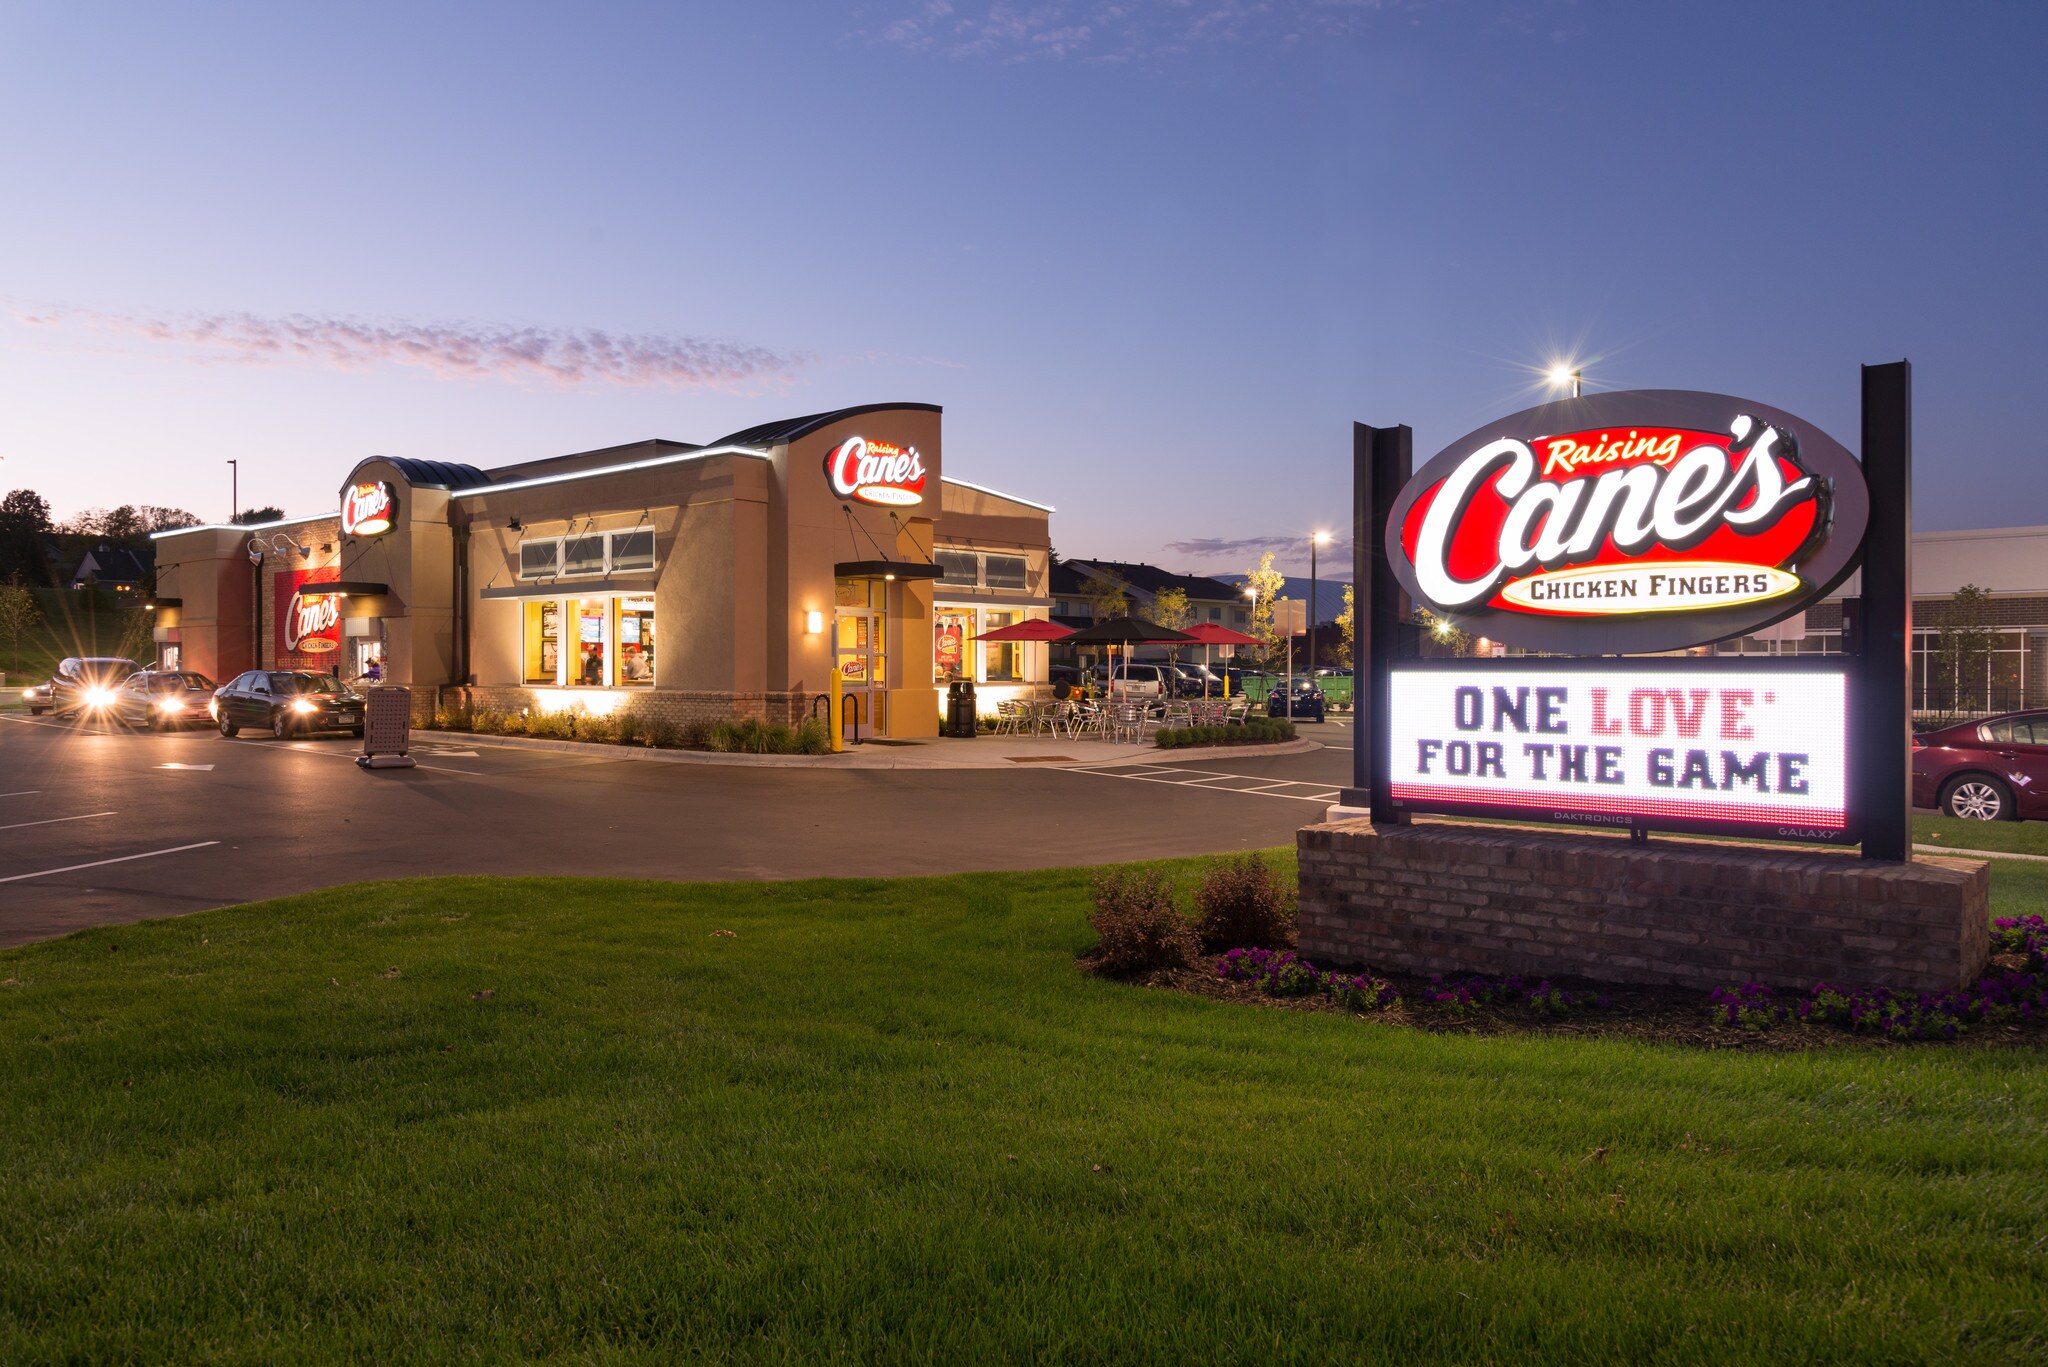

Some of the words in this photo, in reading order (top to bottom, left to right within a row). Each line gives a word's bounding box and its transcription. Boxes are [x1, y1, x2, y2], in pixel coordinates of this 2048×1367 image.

[834, 436, 926, 495] Cane's
[866, 441, 899, 458] Raising
[1543, 433, 1682, 476] Raising
[342, 481, 389, 534] Cane's
[1415, 414, 1809, 605] Cane's
[1530, 579, 1638, 600] CHICKEN
[1649, 574, 1769, 596] FINGERS
[1455, 686, 1568, 735] ONE
[1417, 738, 1506, 779] FOR
[1523, 742, 1626, 785] THE
[1647, 748, 1809, 796] GAME
[1554, 812, 1633, 824] DAKTRONICS
